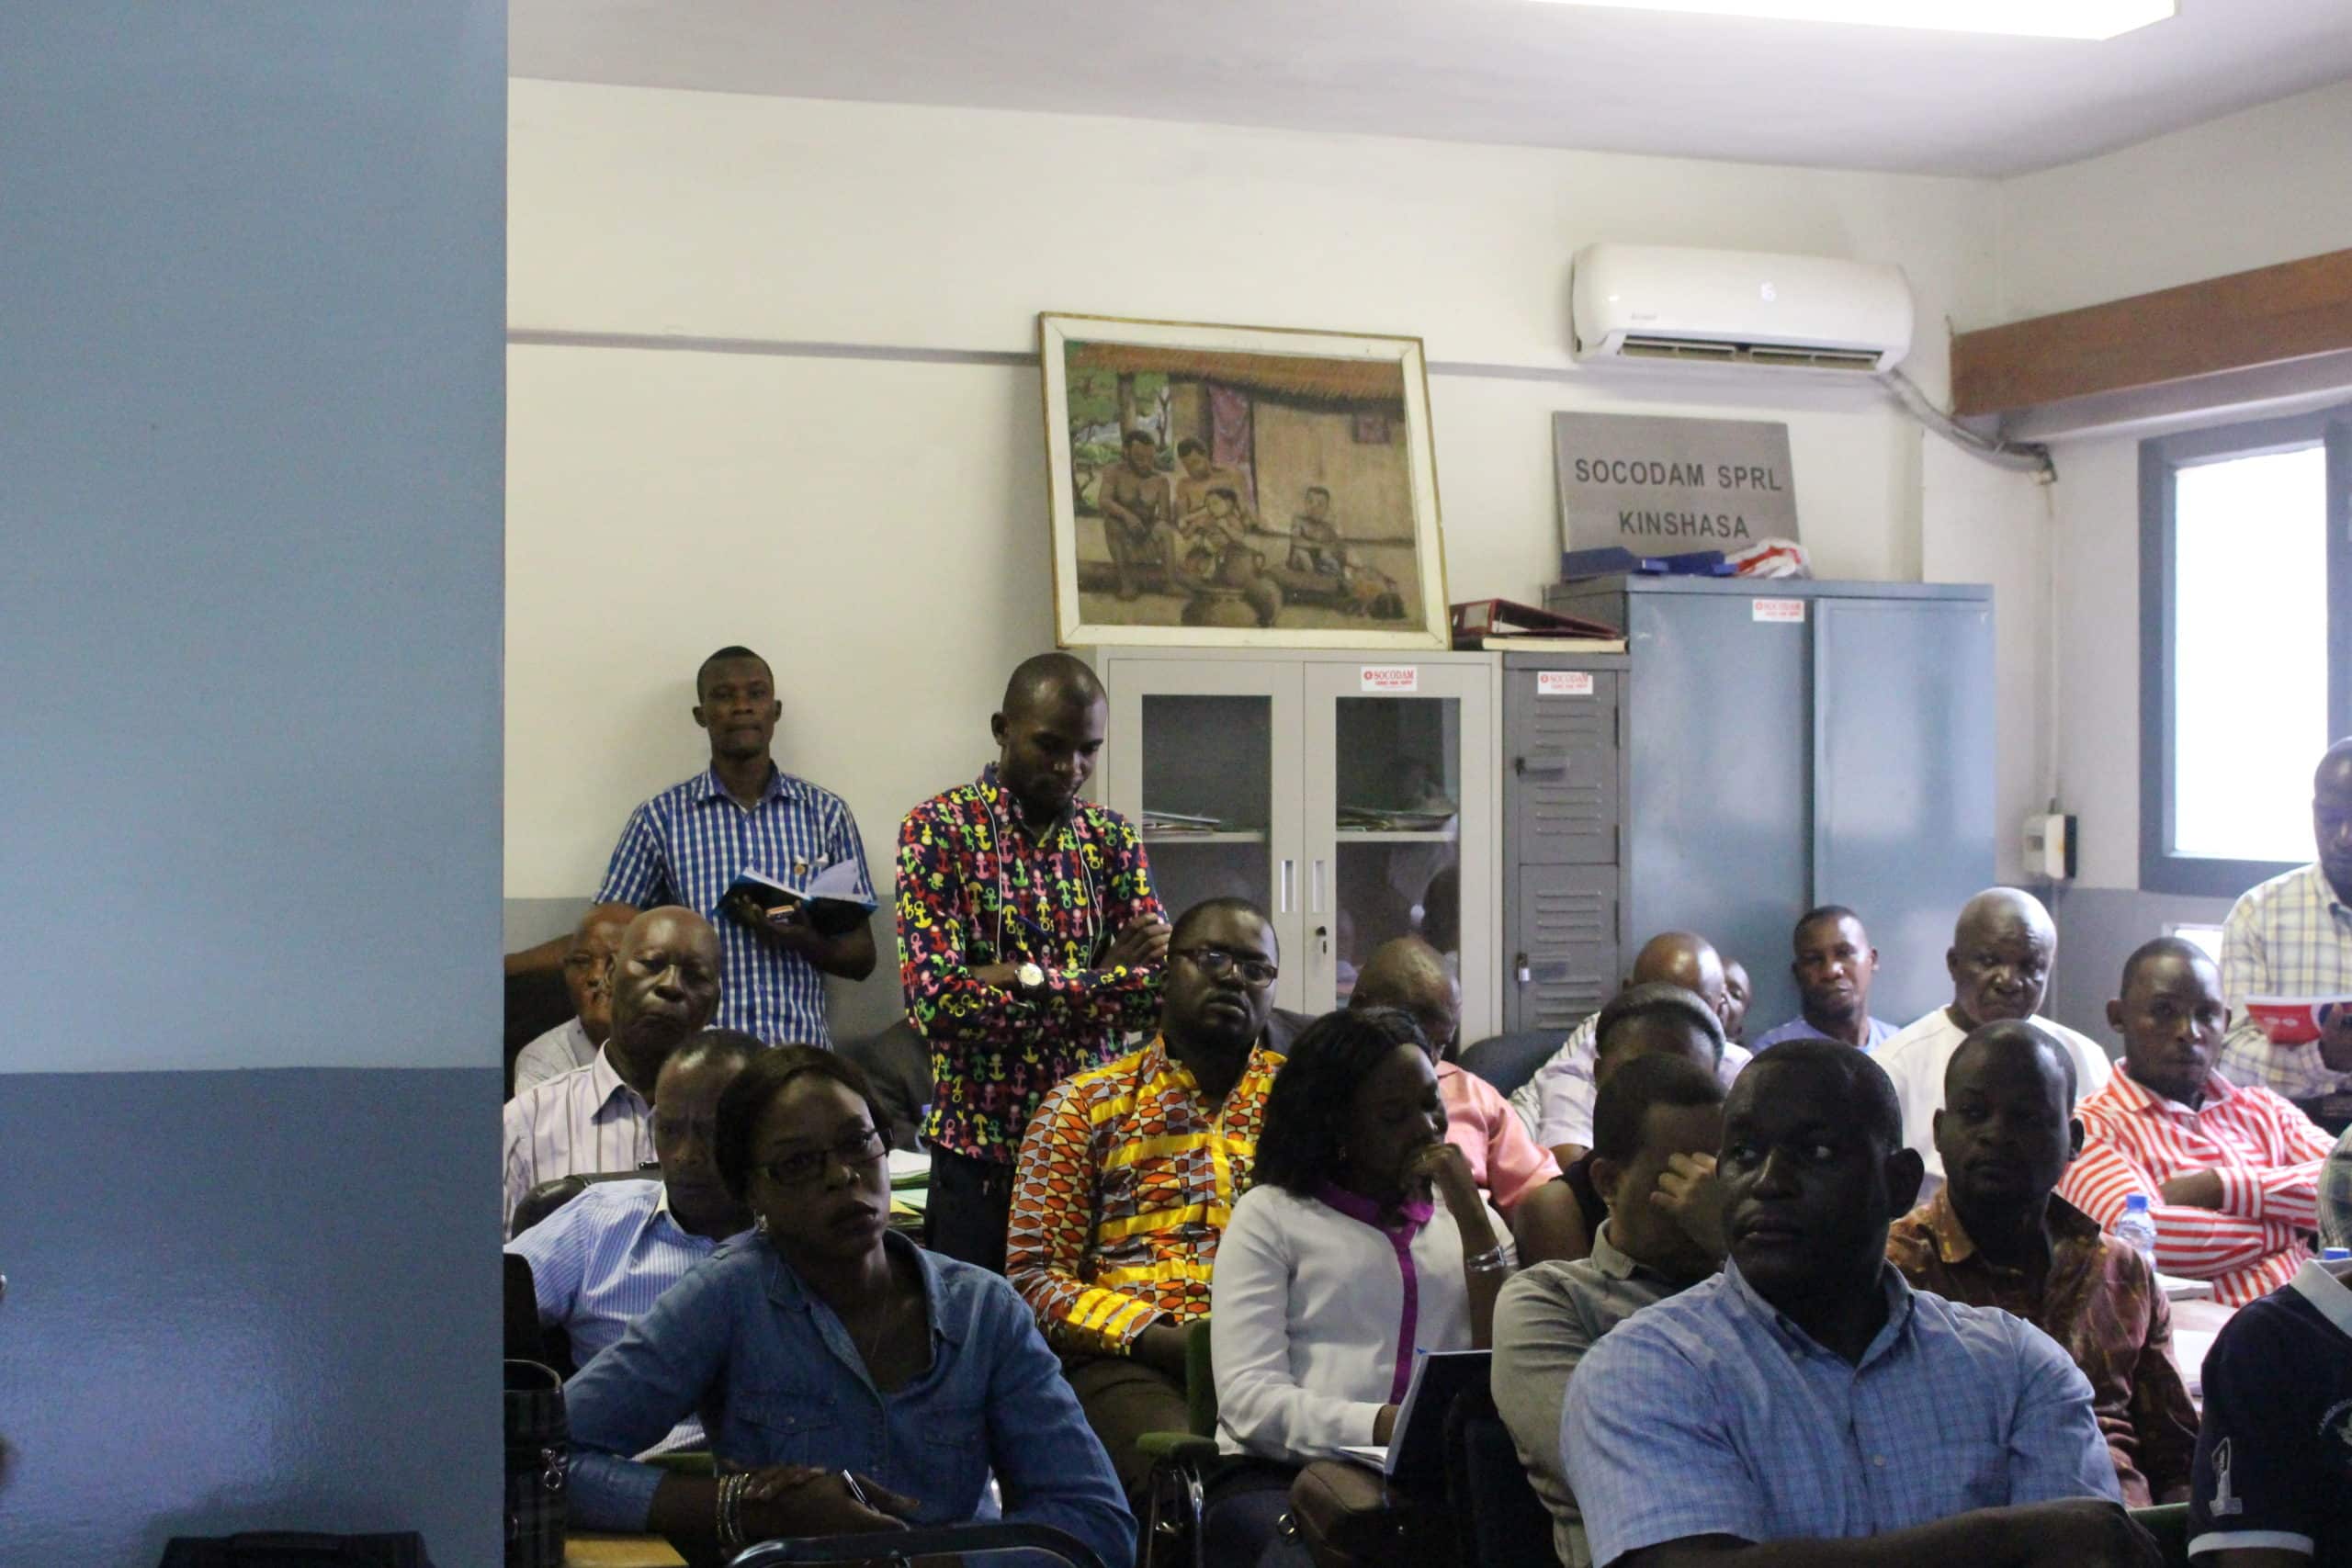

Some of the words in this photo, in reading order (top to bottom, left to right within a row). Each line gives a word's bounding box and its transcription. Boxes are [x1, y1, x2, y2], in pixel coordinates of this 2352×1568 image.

[1575, 458, 1704, 487] SOCODAM
[1717, 465, 1782, 491] SPRL
[1619, 510, 1750, 538] KINSHASA
[1374, 670, 1414, 680] SOCODAM
[2209, 1436, 2243, 1517] 1
